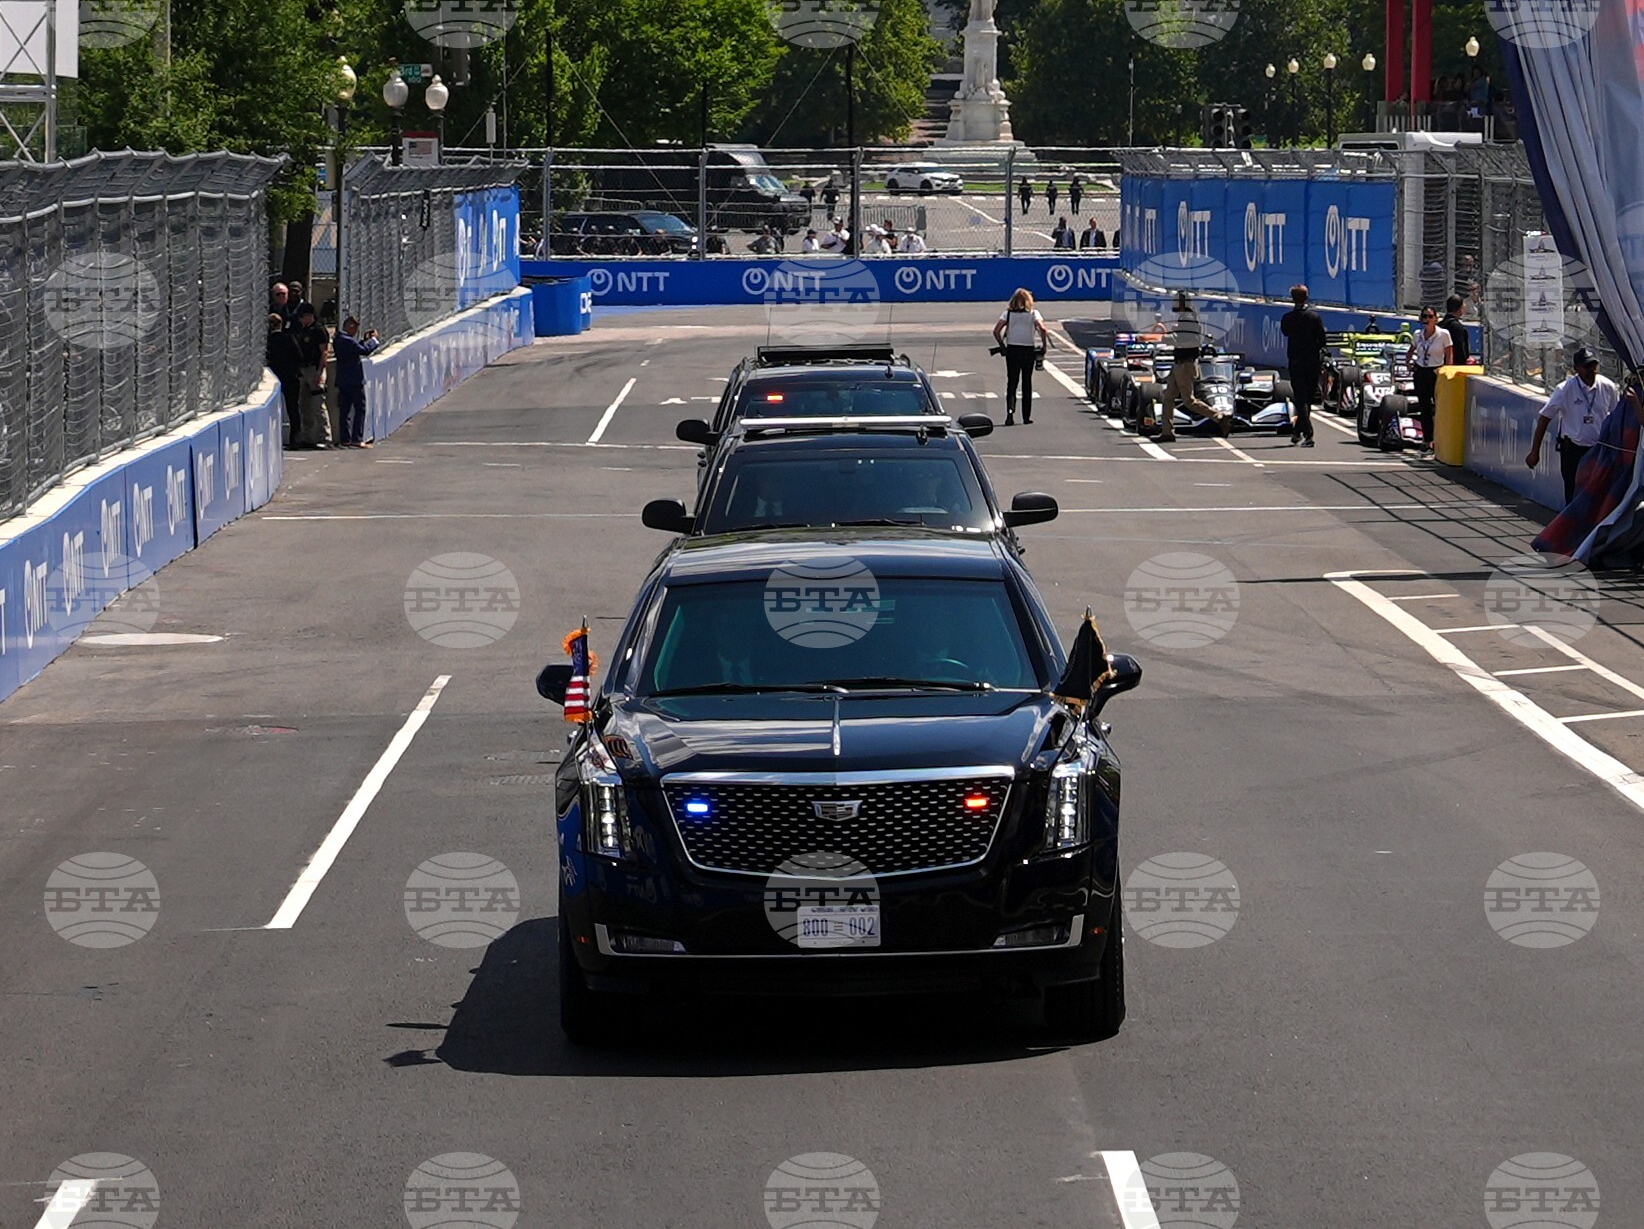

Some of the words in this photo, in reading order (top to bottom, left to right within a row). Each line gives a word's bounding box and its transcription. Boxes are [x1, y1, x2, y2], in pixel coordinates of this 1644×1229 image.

[1341, 217, 1370, 272] NTT
[617, 271, 670, 292] NTT
[774, 271, 826, 292] NTT
[926, 269, 977, 290] NTT
[803, 918, 828, 937] 800
[849, 916, 876, 936] 002
